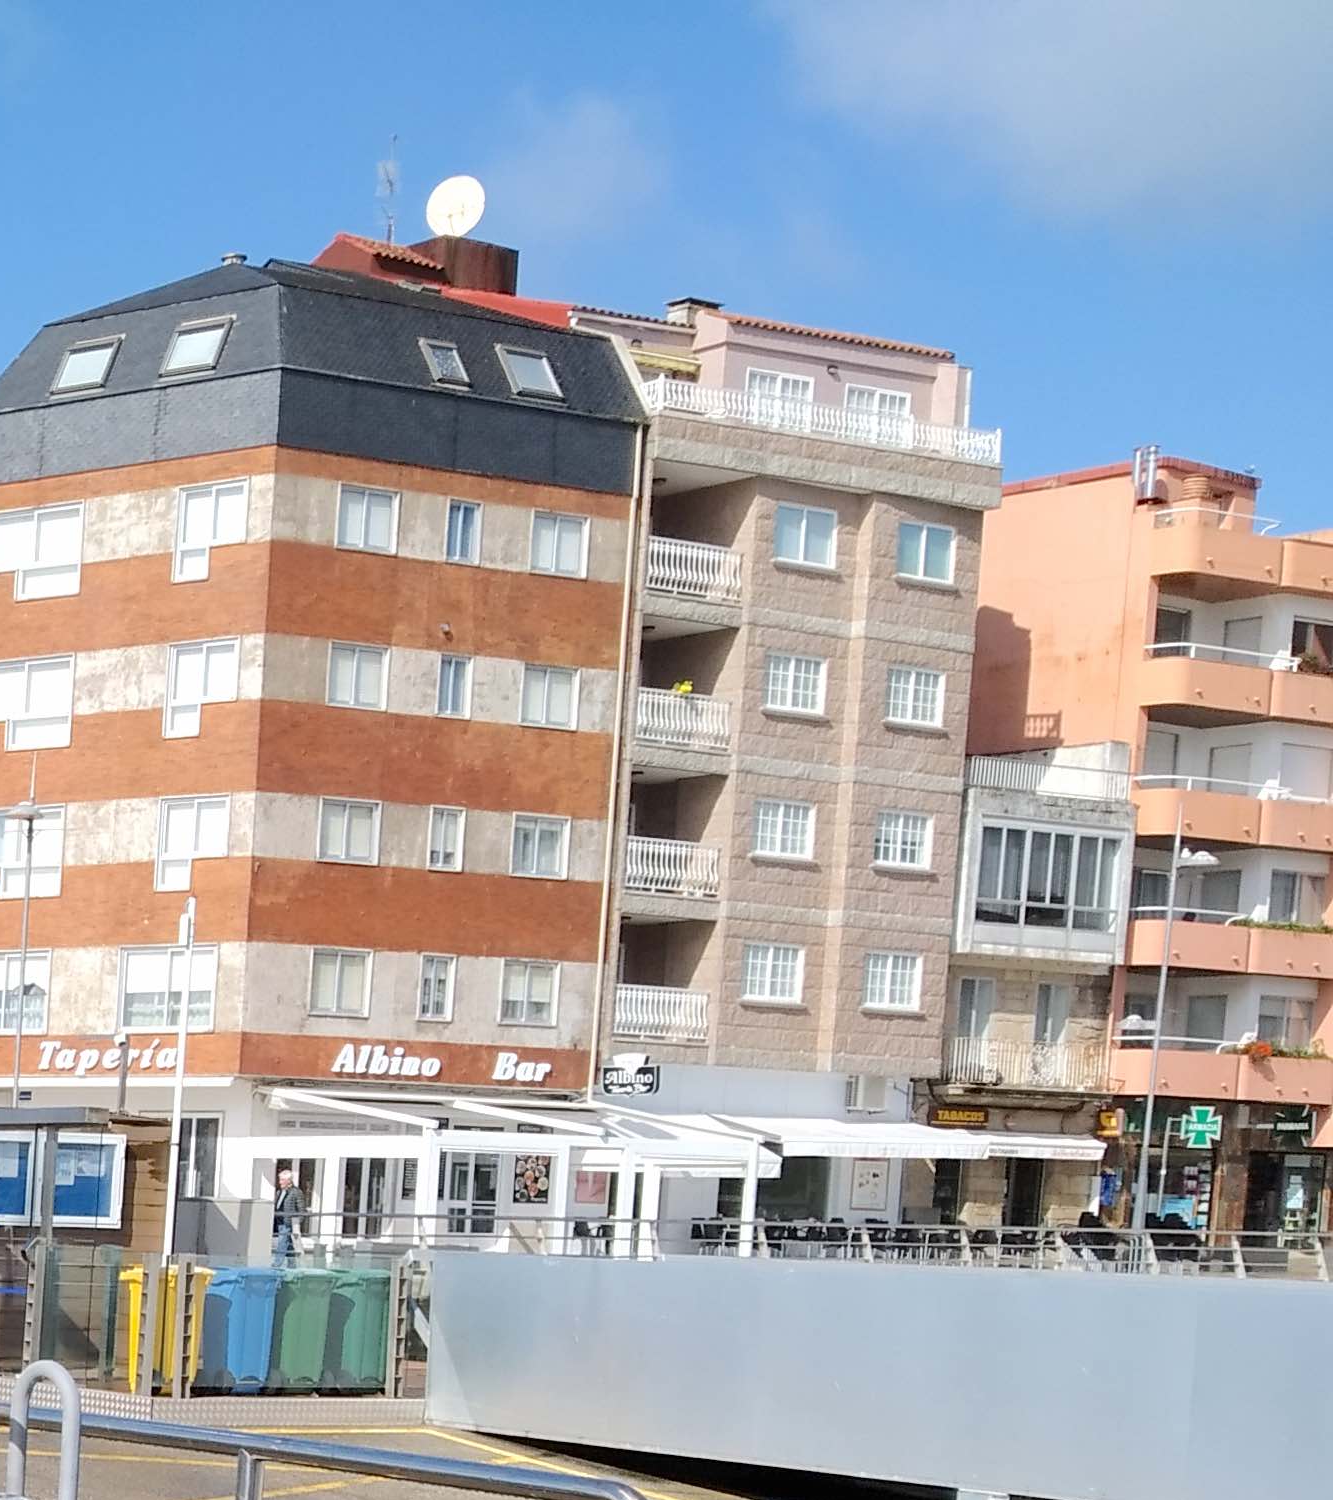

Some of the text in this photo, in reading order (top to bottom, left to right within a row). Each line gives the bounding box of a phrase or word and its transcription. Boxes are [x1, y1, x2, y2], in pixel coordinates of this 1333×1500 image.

[38, 1038, 178, 1077] Tapería
[331, 1043, 551, 1082] Albino Bar
[605, 1070, 653, 1084] Albino
[937, 1110, 985, 1122] TABACOS
